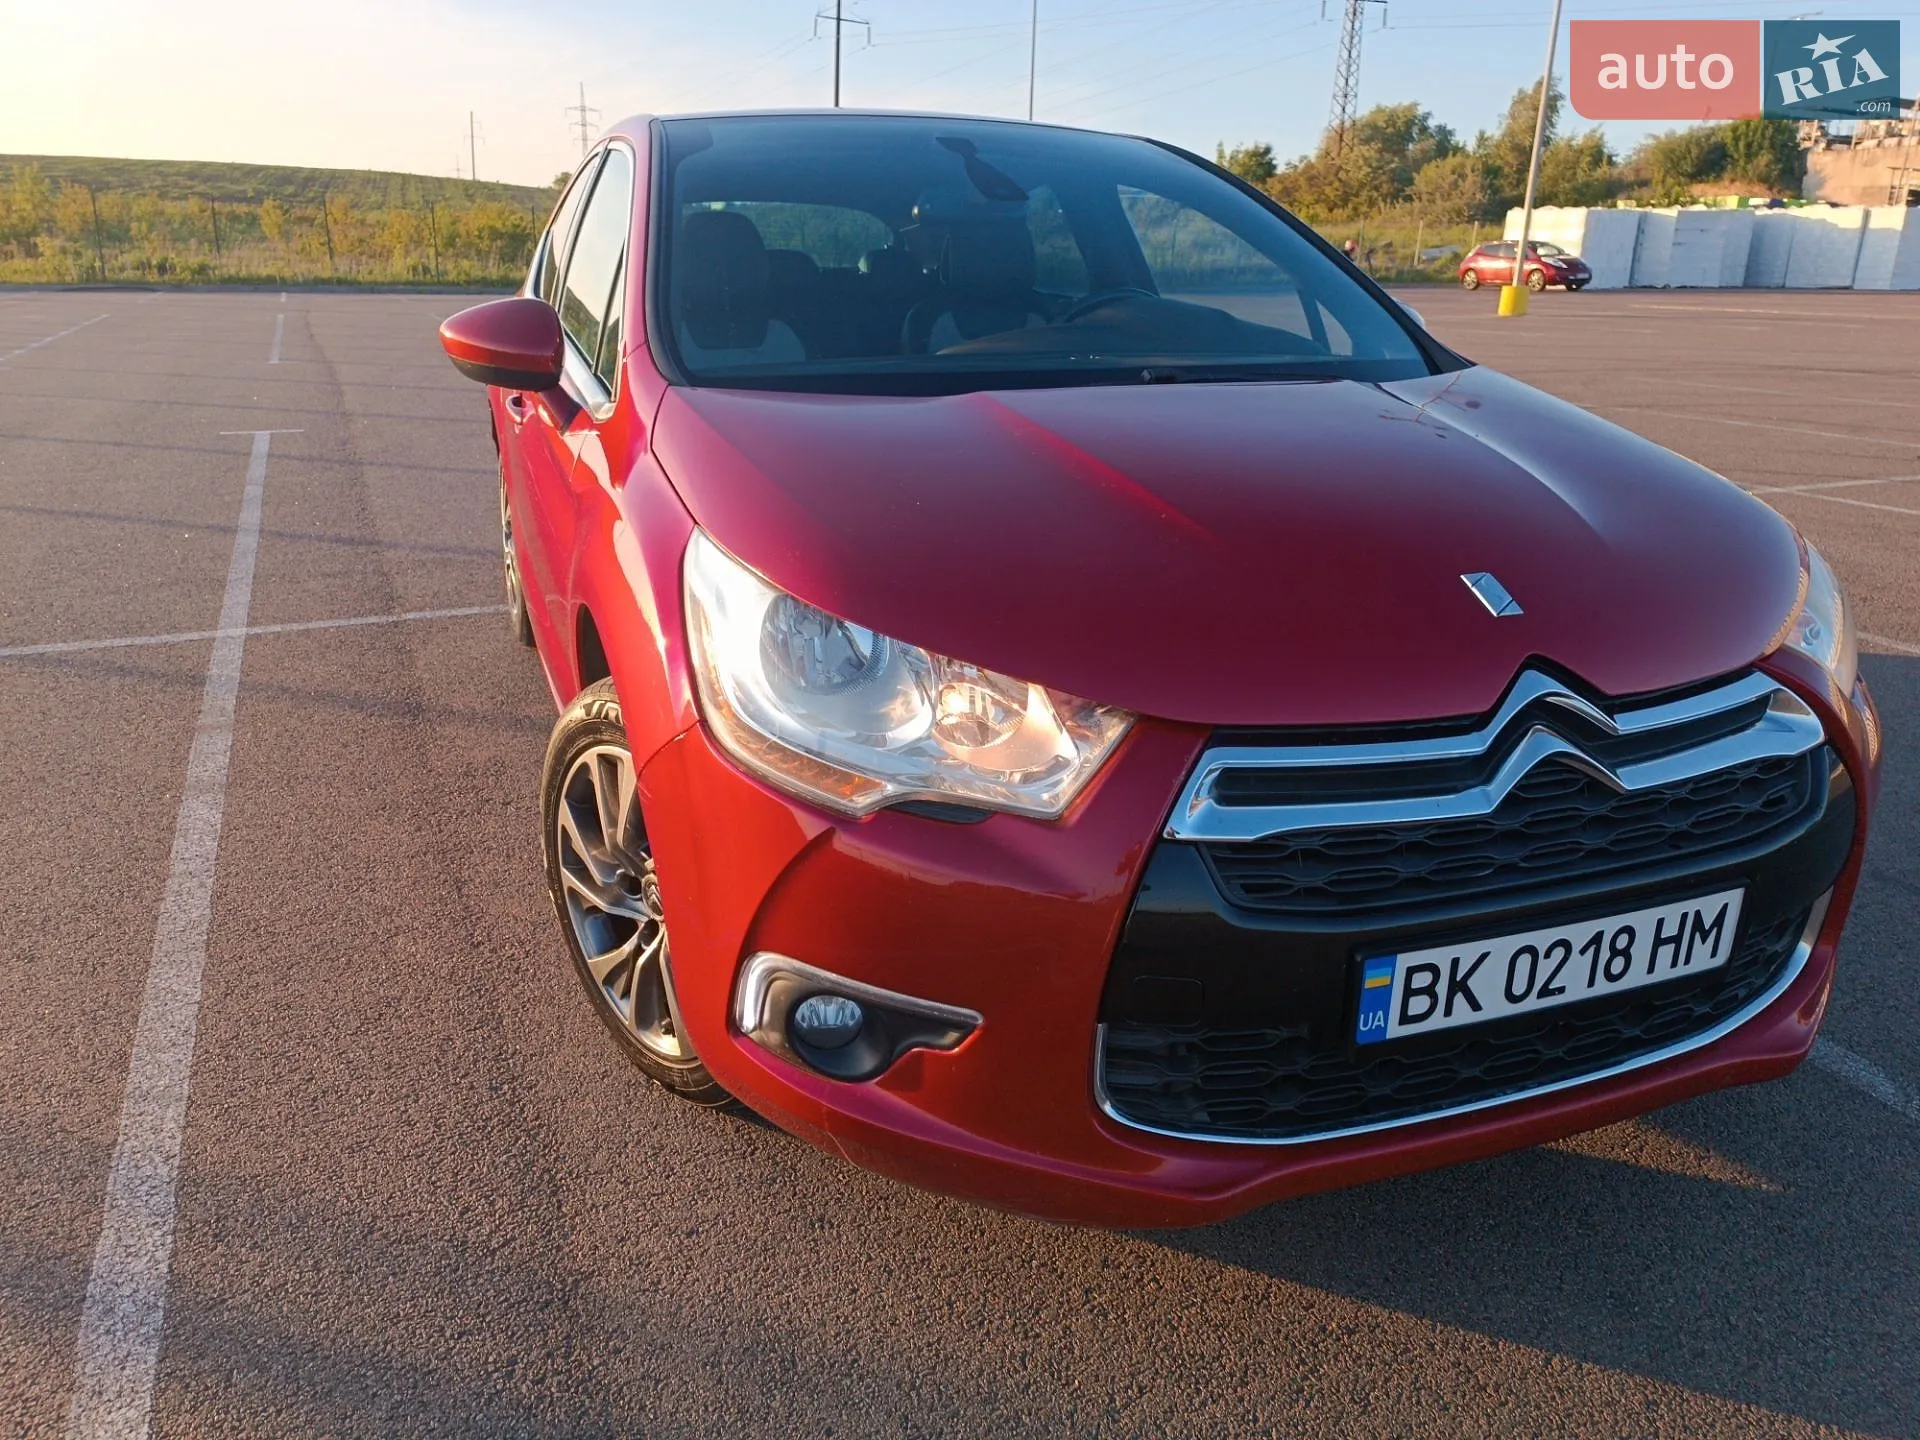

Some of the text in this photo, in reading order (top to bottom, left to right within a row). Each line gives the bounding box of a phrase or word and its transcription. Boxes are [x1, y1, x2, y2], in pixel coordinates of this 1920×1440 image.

[1398, 902, 1729, 1027] BK 0218 HM
[1360, 1010, 1385, 1031] UA
